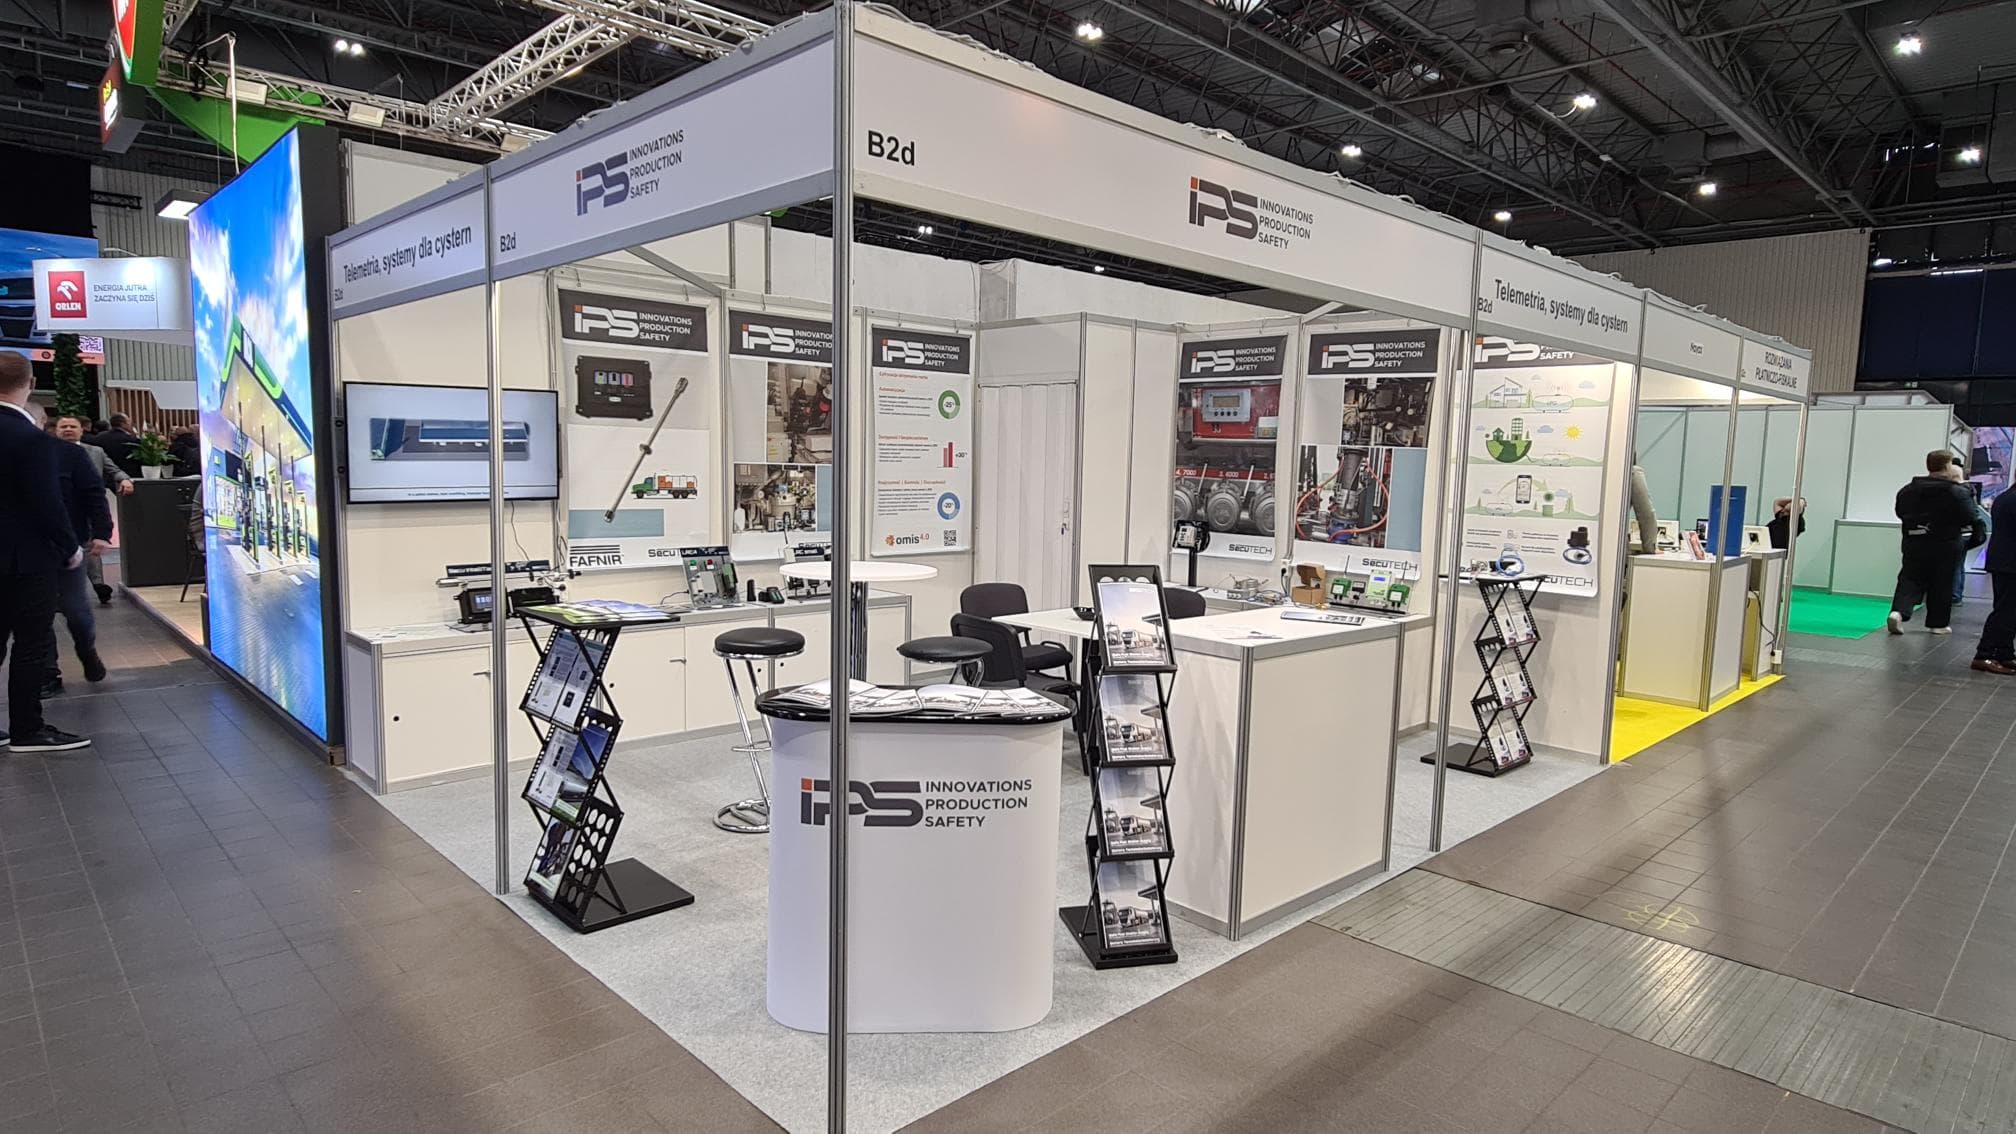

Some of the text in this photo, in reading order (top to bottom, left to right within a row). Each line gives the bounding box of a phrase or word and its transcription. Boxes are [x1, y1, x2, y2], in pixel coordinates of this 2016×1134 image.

[629, 129, 684, 161] INNOVATIONS
[867, 129, 915, 166] B2d
[629, 150, 682, 180] PRODUCTION
[630, 178, 660, 199] SAFETY
[1260, 198, 1314, 225] INNOVATIONS
[1259, 215, 1311, 240] PRODUCTION
[500, 232, 517, 252] B2d
[1258, 231, 1290, 250] SAFETY
[343, 225, 472, 283] Telemetria, systemy dla cystern
[93, 284, 124, 292] ENERGIA
[94, 294, 126, 302] ZACZYNA
[55, 302, 81, 311] ORLEN
[1478, 297, 1493, 314] B2d
[1494, 278, 1628, 334] Telemetria, systemy dla cystern
[639, 312, 692, 325] INNOVATIONS
[639, 322, 691, 335] PRODUCTION
[639, 331, 671, 342] SAFETY
[794, 338, 833, 349] PRODUCTIO
[924, 343, 960, 353] INNOVATIONS
[1375, 341, 1426, 350] INNOVATIONS
[795, 347, 821, 356] SAFETY
[924, 351, 959, 361] PRODUCTION
[1235, 346, 1276, 355] INNOVATIONS
[1375, 350, 1423, 359] PRODUCTION
[1539, 350, 1575, 360] SAFETY
[1235, 354, 1275, 363] PRODUCTION
[1374, 360, 1402, 368] SAFETY
[896, 533, 920, 545] omis
[569, 554, 622, 567] FAFNIR
[925, 779, 1032, 793] INNOVATIONS
[925, 797, 1028, 810] PRODUCTION
[924, 816, 986, 828] SAFETY
